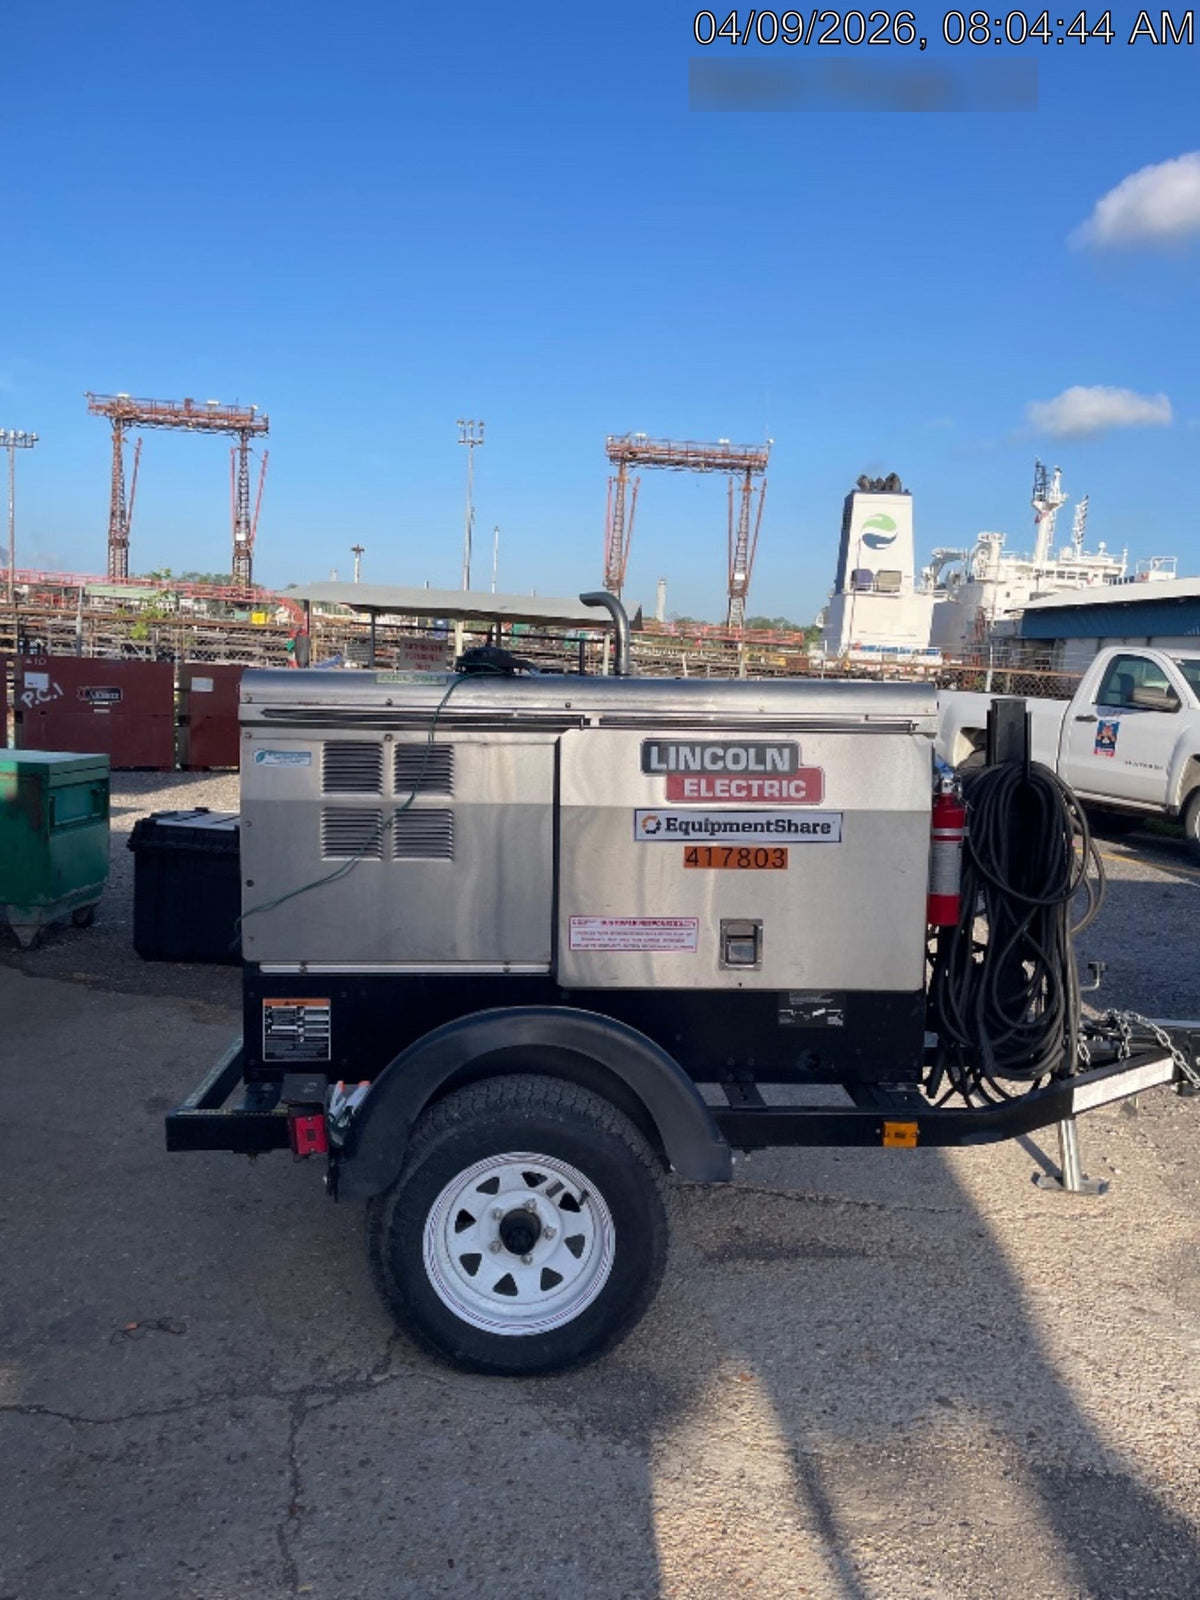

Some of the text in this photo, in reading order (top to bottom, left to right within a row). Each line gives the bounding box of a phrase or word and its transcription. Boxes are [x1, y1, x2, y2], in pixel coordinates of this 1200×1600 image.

[650, 746, 790, 772] LINCOLN
[683, 778, 806, 798] ELECTRIC
[665, 818, 831, 835] EquipmentShare
[686, 847, 786, 868] 417803
